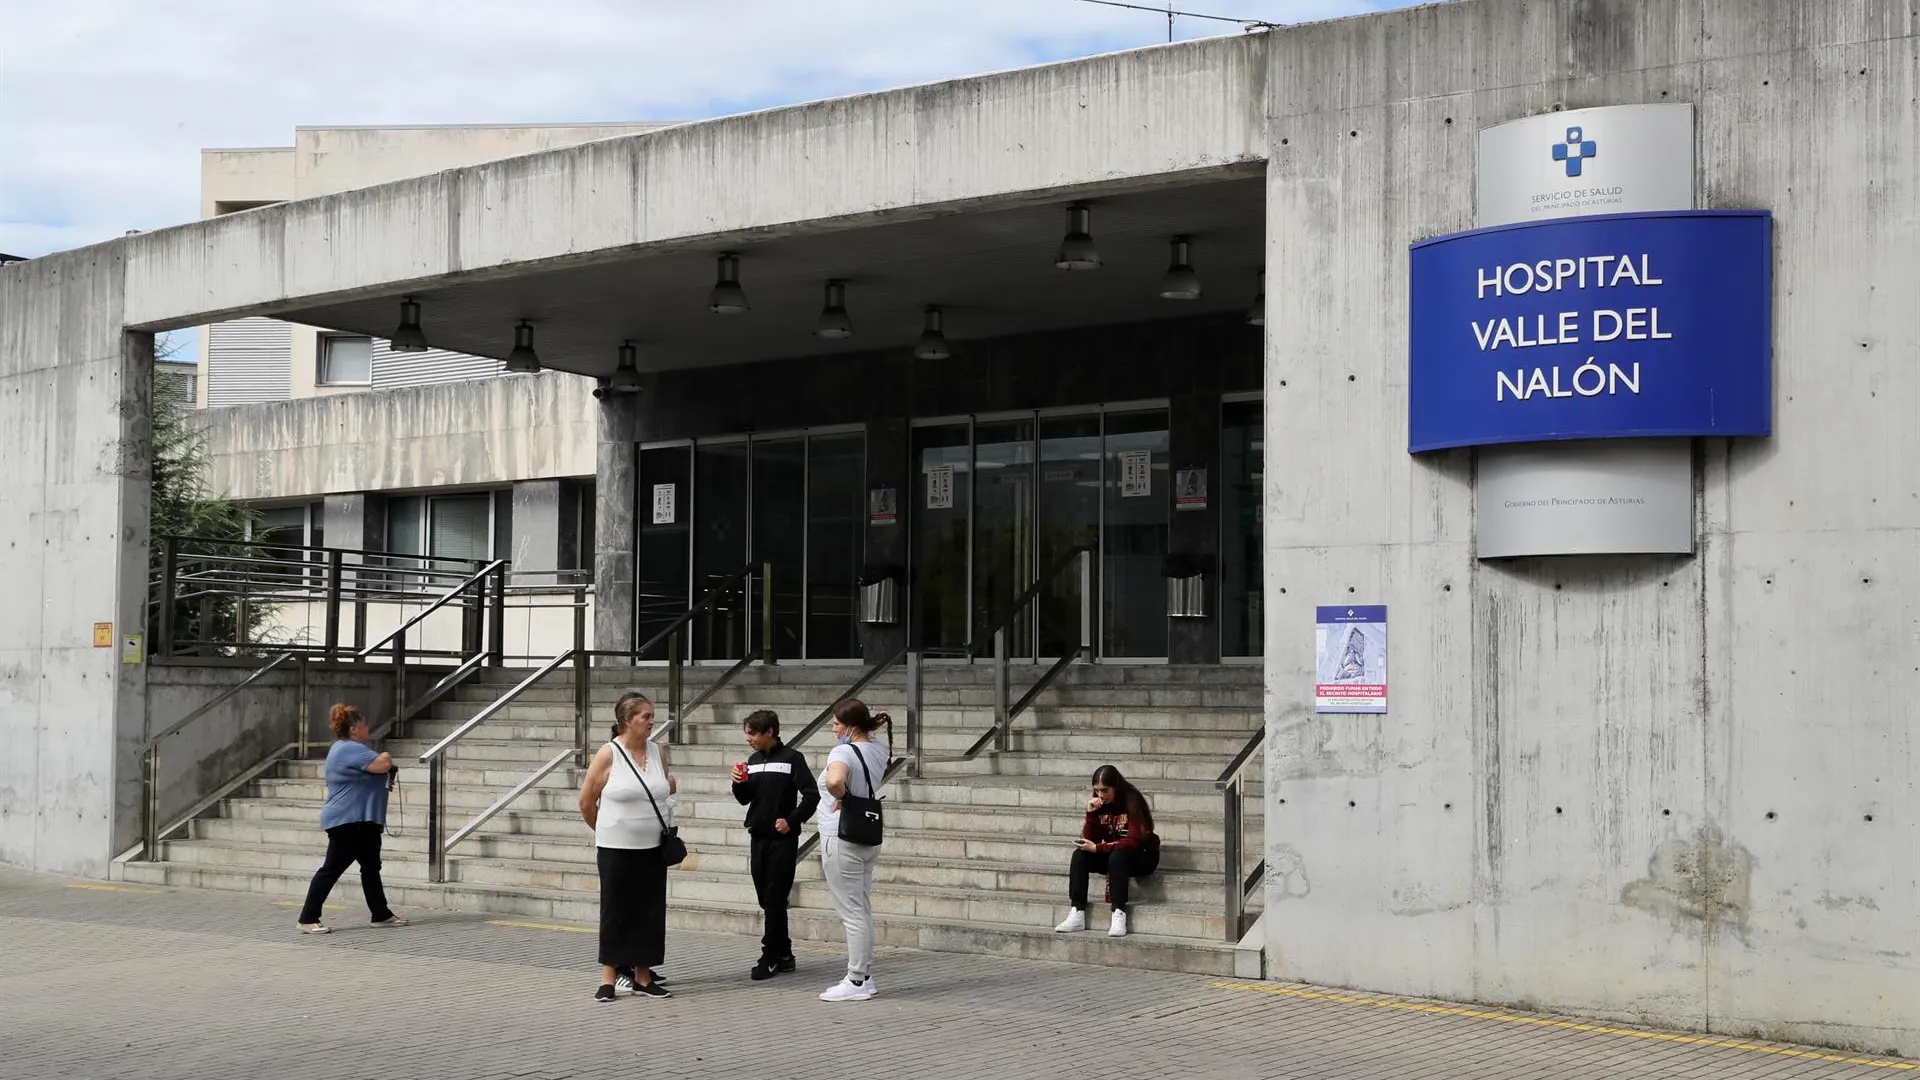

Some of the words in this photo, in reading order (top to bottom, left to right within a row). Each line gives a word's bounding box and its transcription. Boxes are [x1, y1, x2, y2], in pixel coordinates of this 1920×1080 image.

[1531, 191, 1571, 203] SERVICIO
[1574, 189, 1587, 198] DE
[1590, 186, 1623, 196] SALUD
[1543, 200, 1581, 210] PRINCIPADO
[1591, 197, 1622, 205] ASTURIAS
[1478, 253, 1663, 299] HOSPITAL
[1471, 311, 1579, 351] VALLE
[1593, 307, 1672, 342] DEL
[1497, 356, 1640, 401] NALÓN
